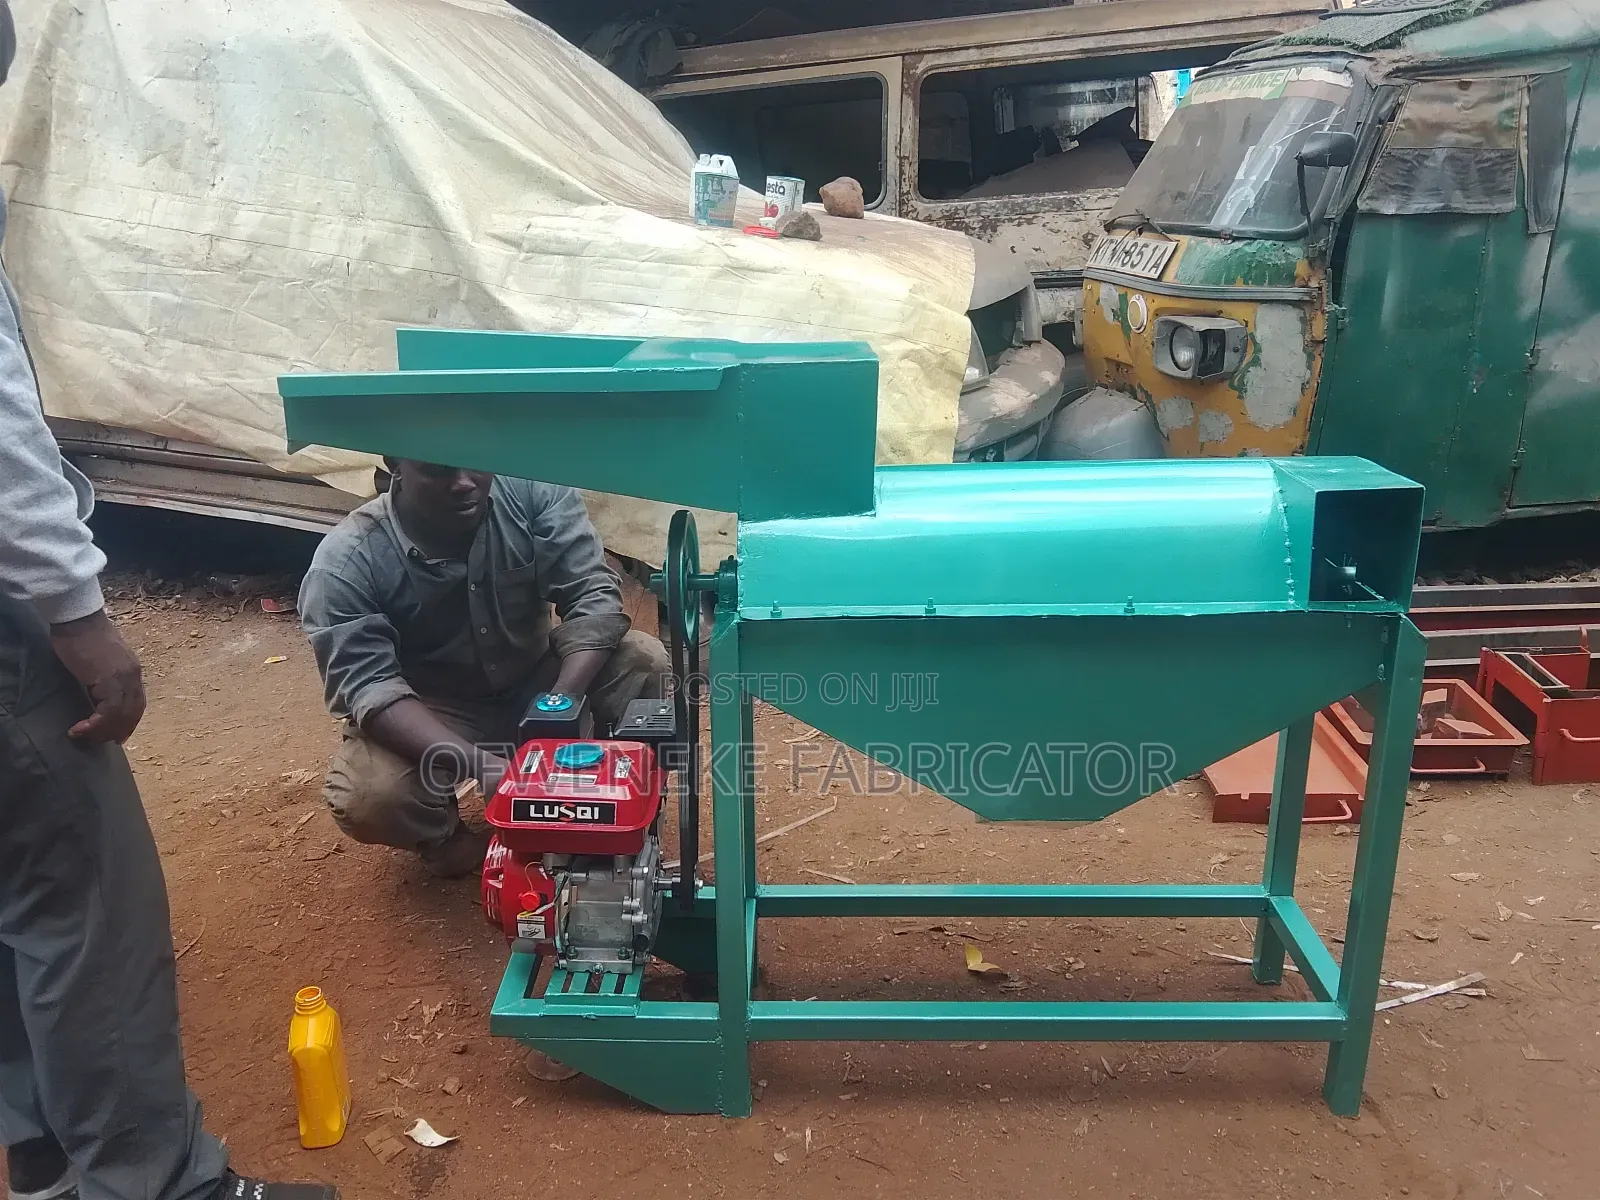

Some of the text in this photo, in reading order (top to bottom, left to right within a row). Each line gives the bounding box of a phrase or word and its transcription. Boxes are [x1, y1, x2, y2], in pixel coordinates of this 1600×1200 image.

[1229, 72, 1285, 92] CHANCE
[529, 803, 600, 822] LUSQI
[235, 1179, 246, 1196] PEAK
